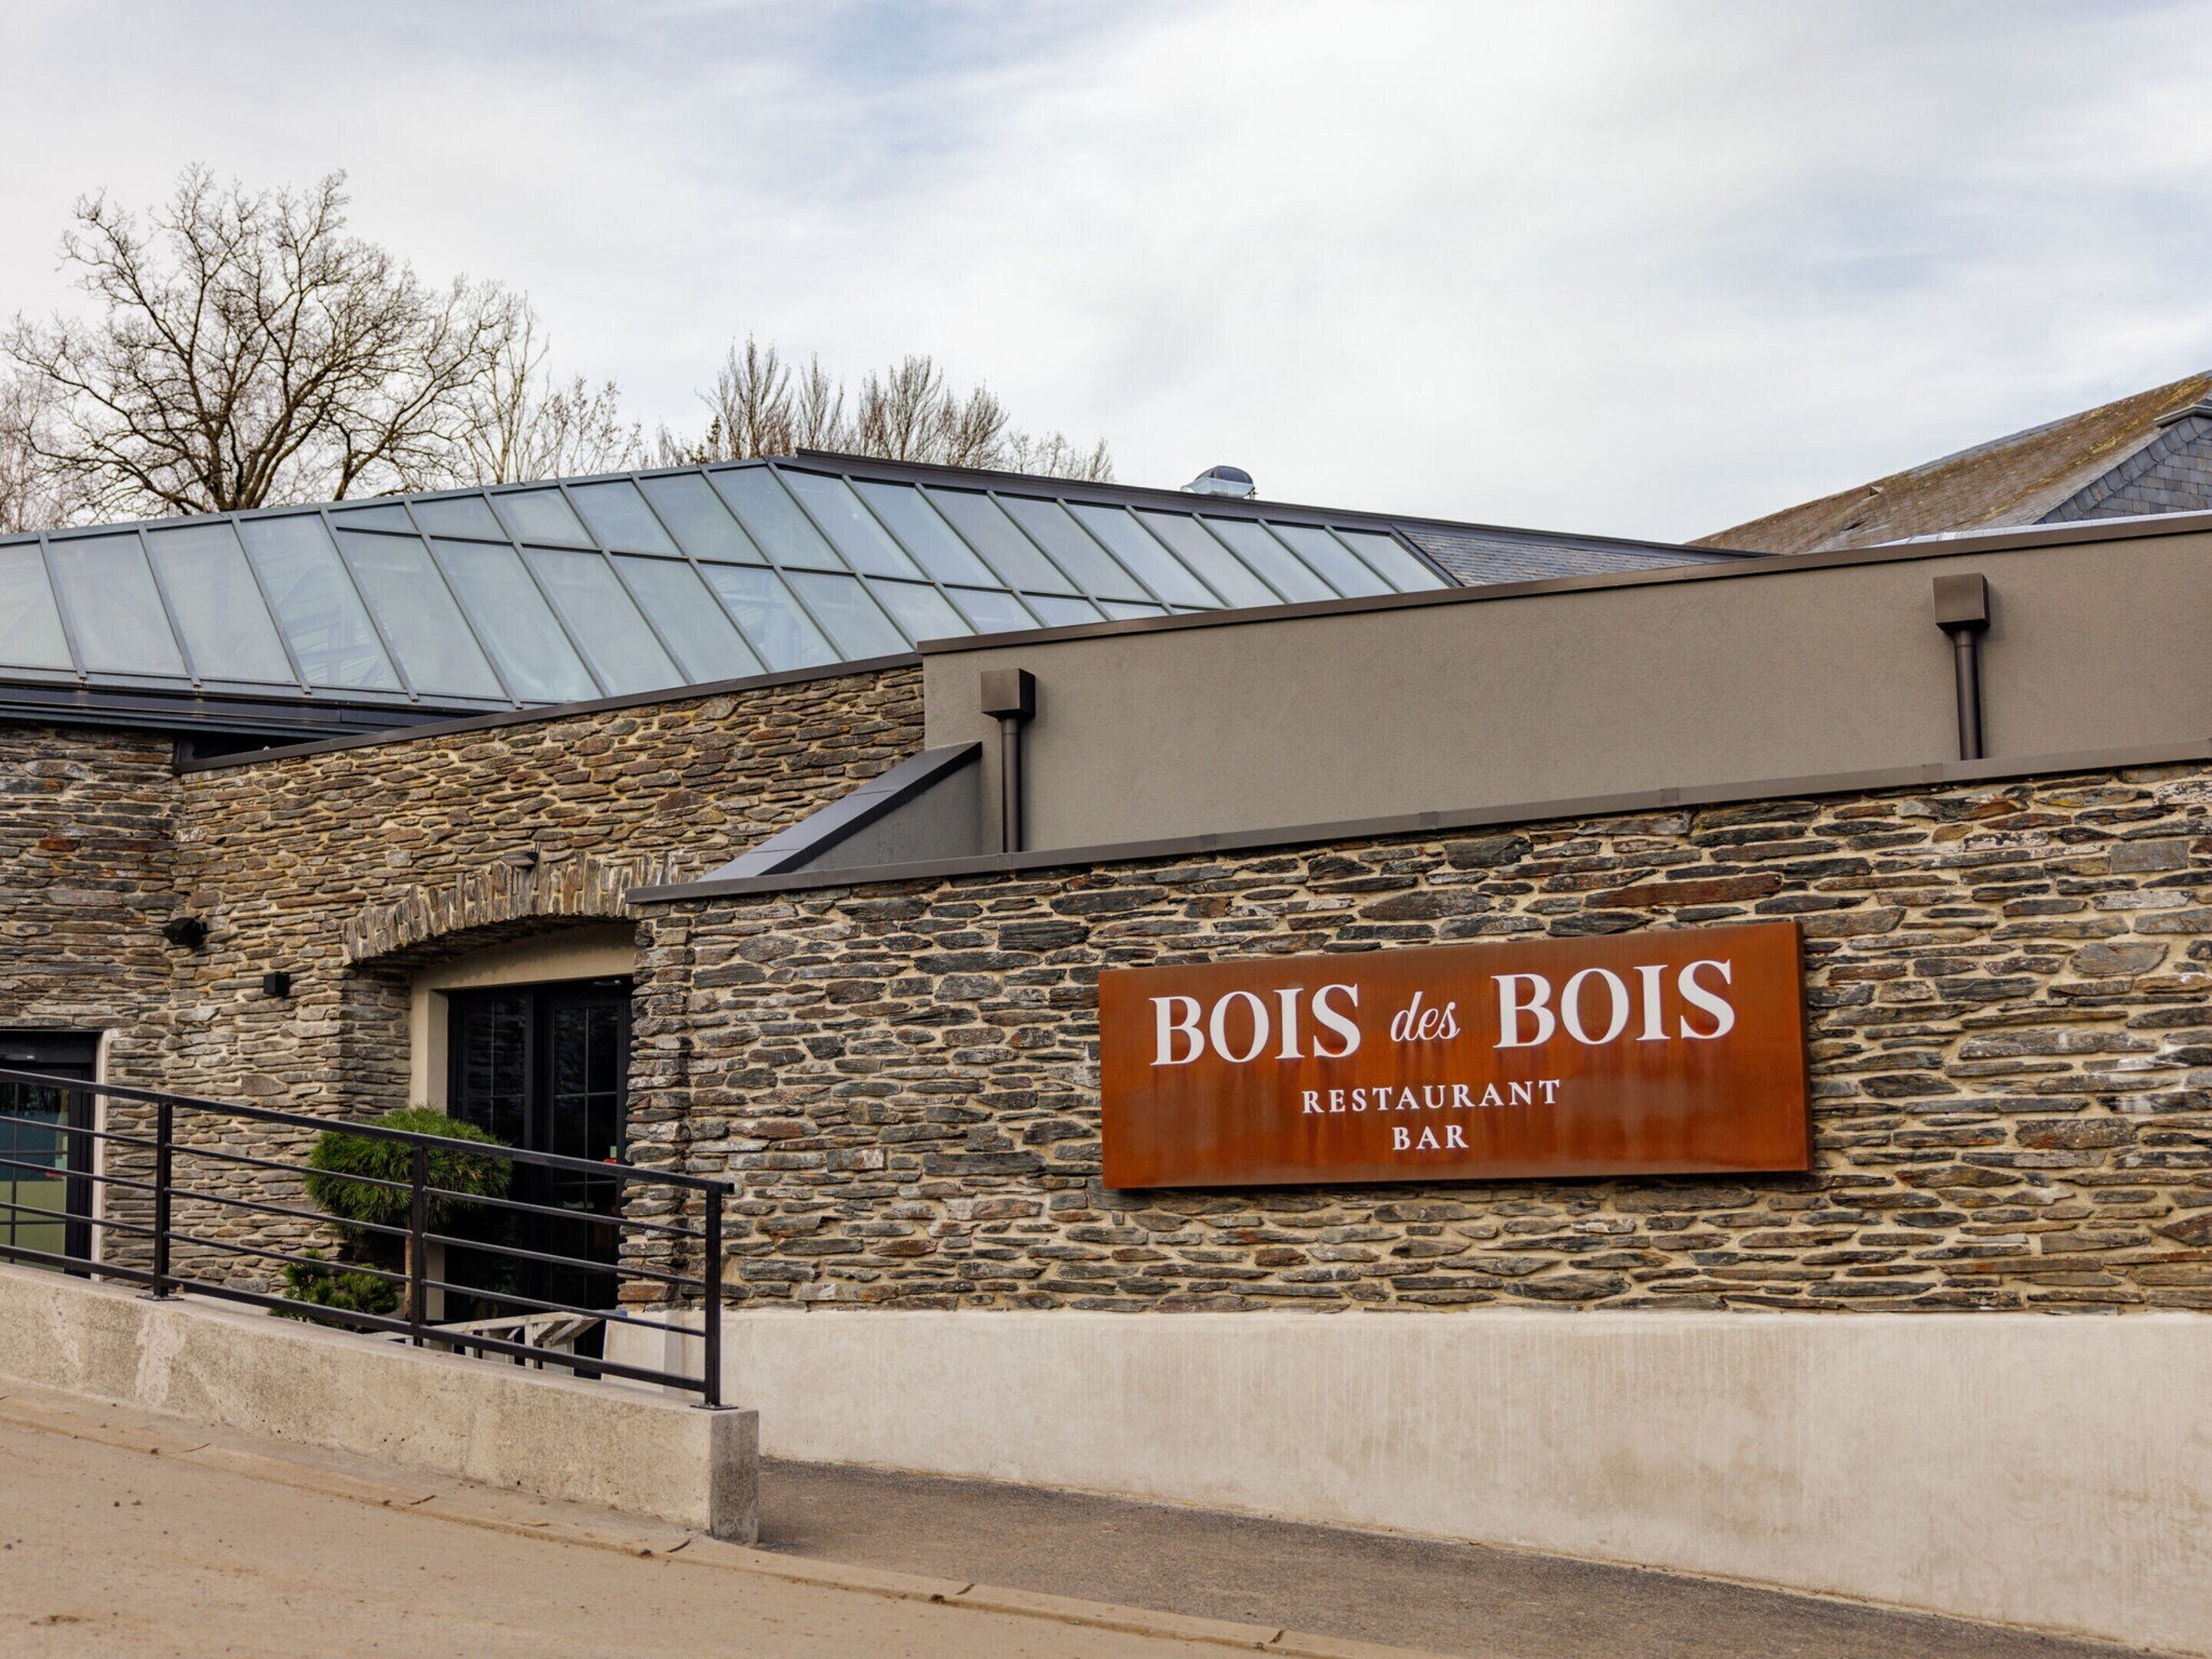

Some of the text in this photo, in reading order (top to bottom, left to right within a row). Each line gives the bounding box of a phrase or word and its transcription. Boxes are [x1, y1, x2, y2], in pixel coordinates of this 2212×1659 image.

[1149, 959, 1734, 1065] BOIS des BOIS
[1303, 1079, 1559, 1113] RESTAURANT
[1392, 1125, 1469, 1149] BAR
